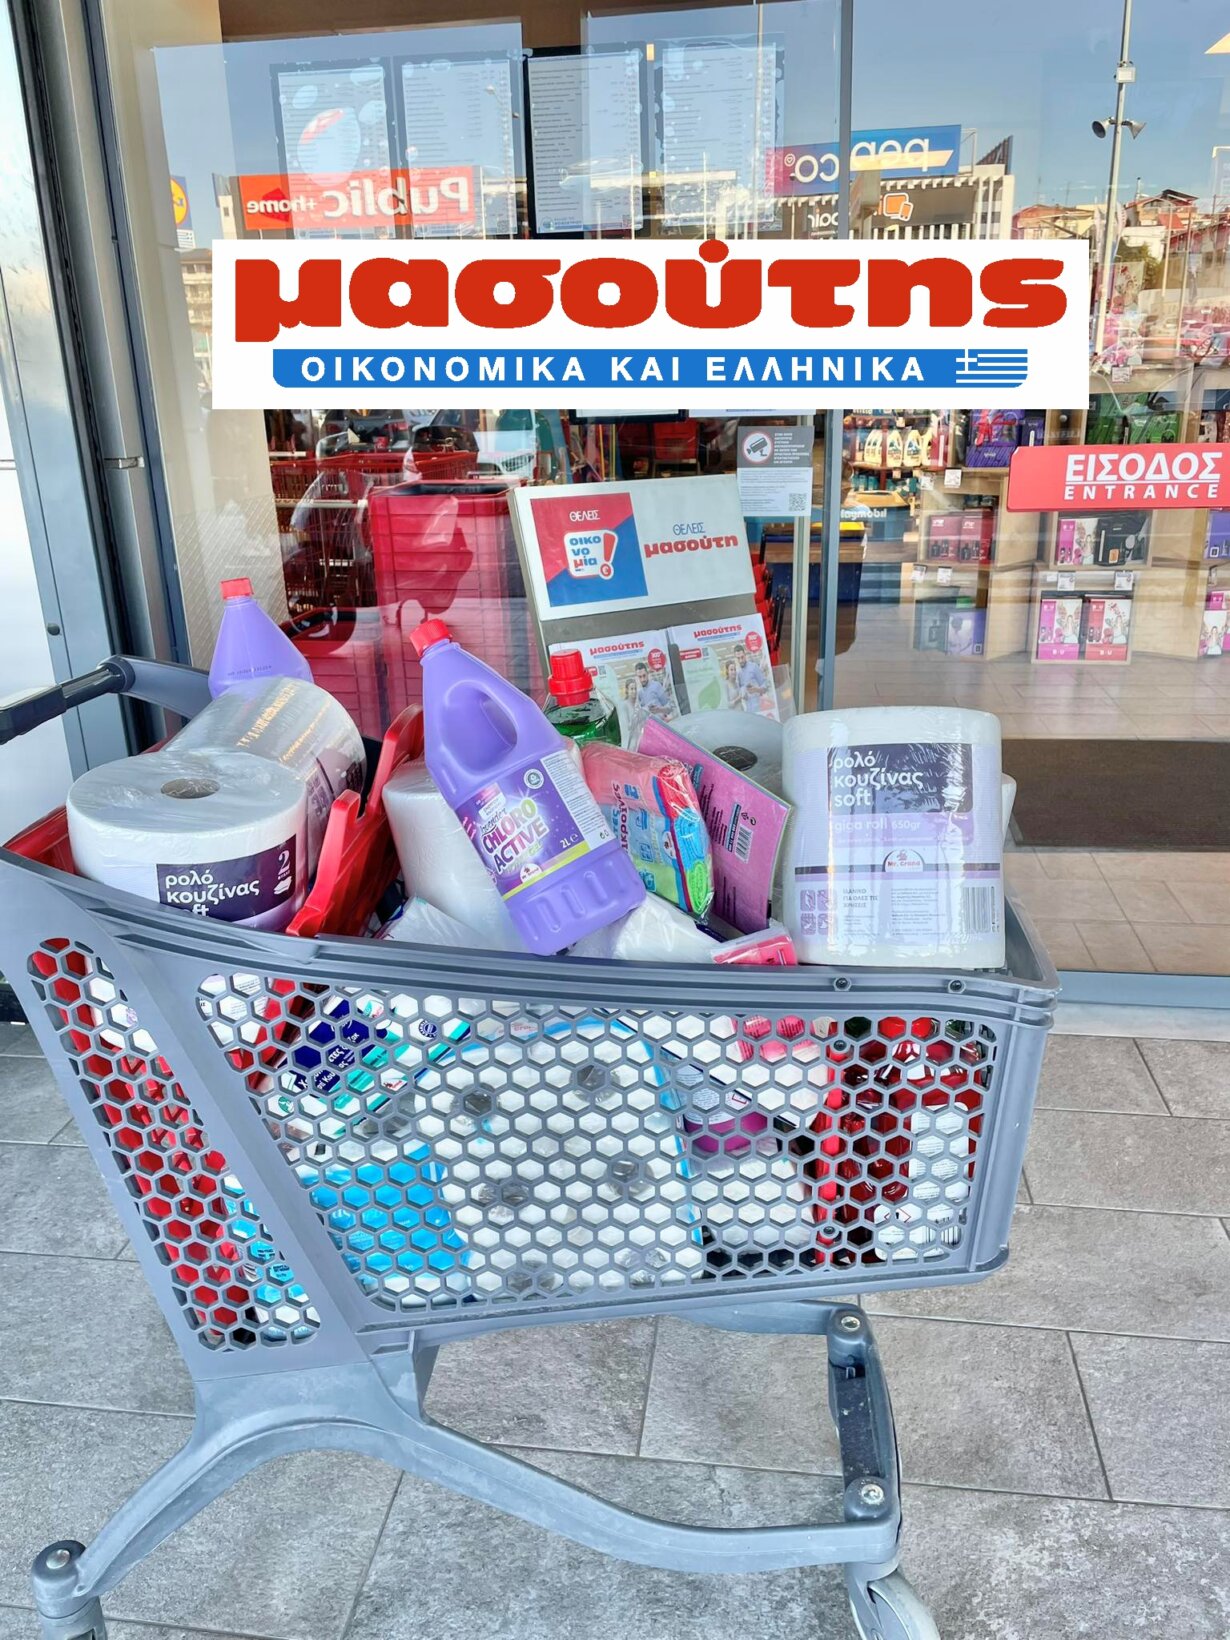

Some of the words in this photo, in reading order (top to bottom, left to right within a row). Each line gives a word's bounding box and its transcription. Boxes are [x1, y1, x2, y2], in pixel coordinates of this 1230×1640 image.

[1065, 452, 1222, 481] ΕΙΣΟΔΟΣ
[1064, 483, 1218, 500] ENTRANCE
[644, 535, 738, 558] μασούτη
[833, 751, 876, 772] ρολό
[834, 768, 923, 790] κουζίνας
[834, 788, 871, 807] soft
[482, 798, 537, 854] CHLORO
[493, 816, 548, 872] ACTIVE
[278, 850, 290, 876] 2
[165, 869, 213, 889] ρολό
[167, 880, 260, 905] κουζίνας
